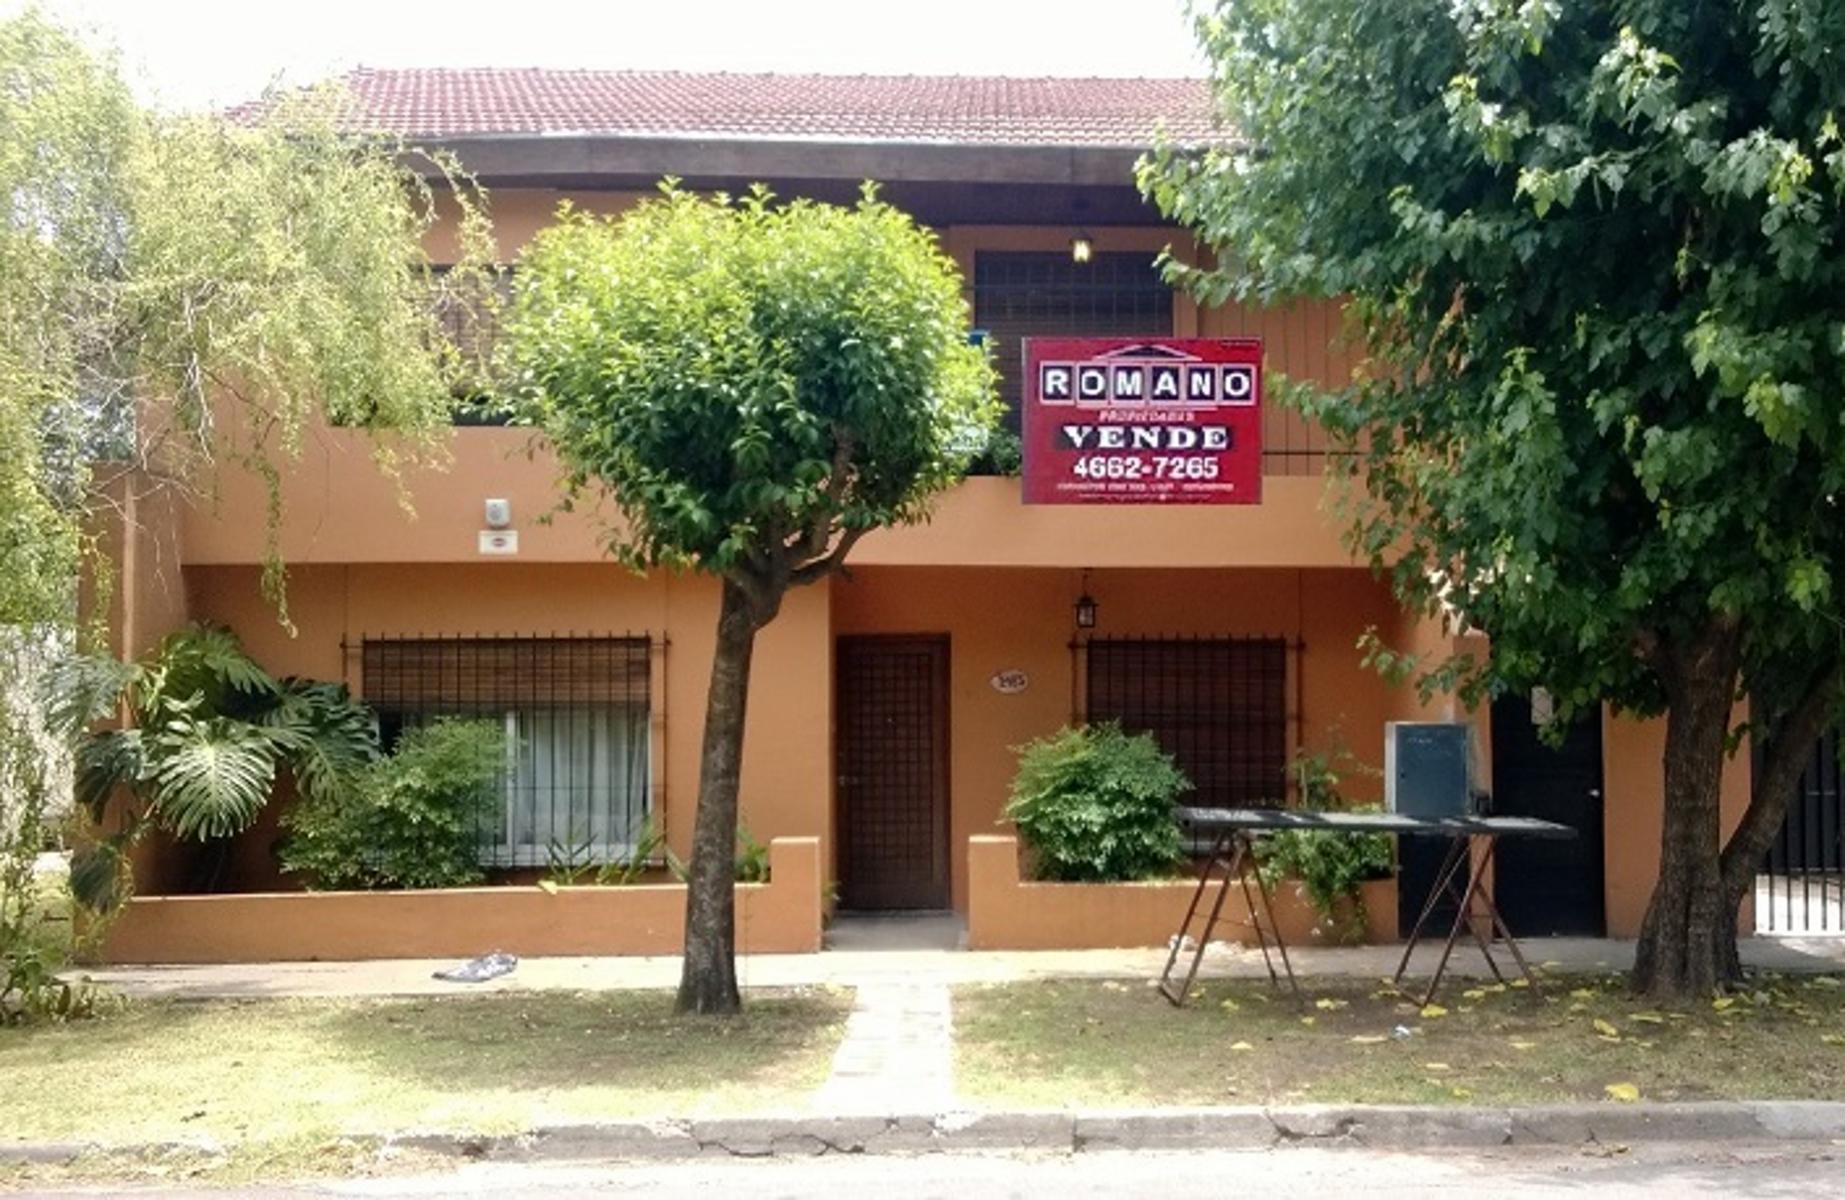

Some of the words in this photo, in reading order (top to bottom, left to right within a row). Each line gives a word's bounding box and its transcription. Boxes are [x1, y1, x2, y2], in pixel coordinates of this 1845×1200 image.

[1045, 369, 1250, 397] ROMANO
[1063, 426, 1229, 449] VENDE
[1073, 457, 1219, 479] 4662-7265
